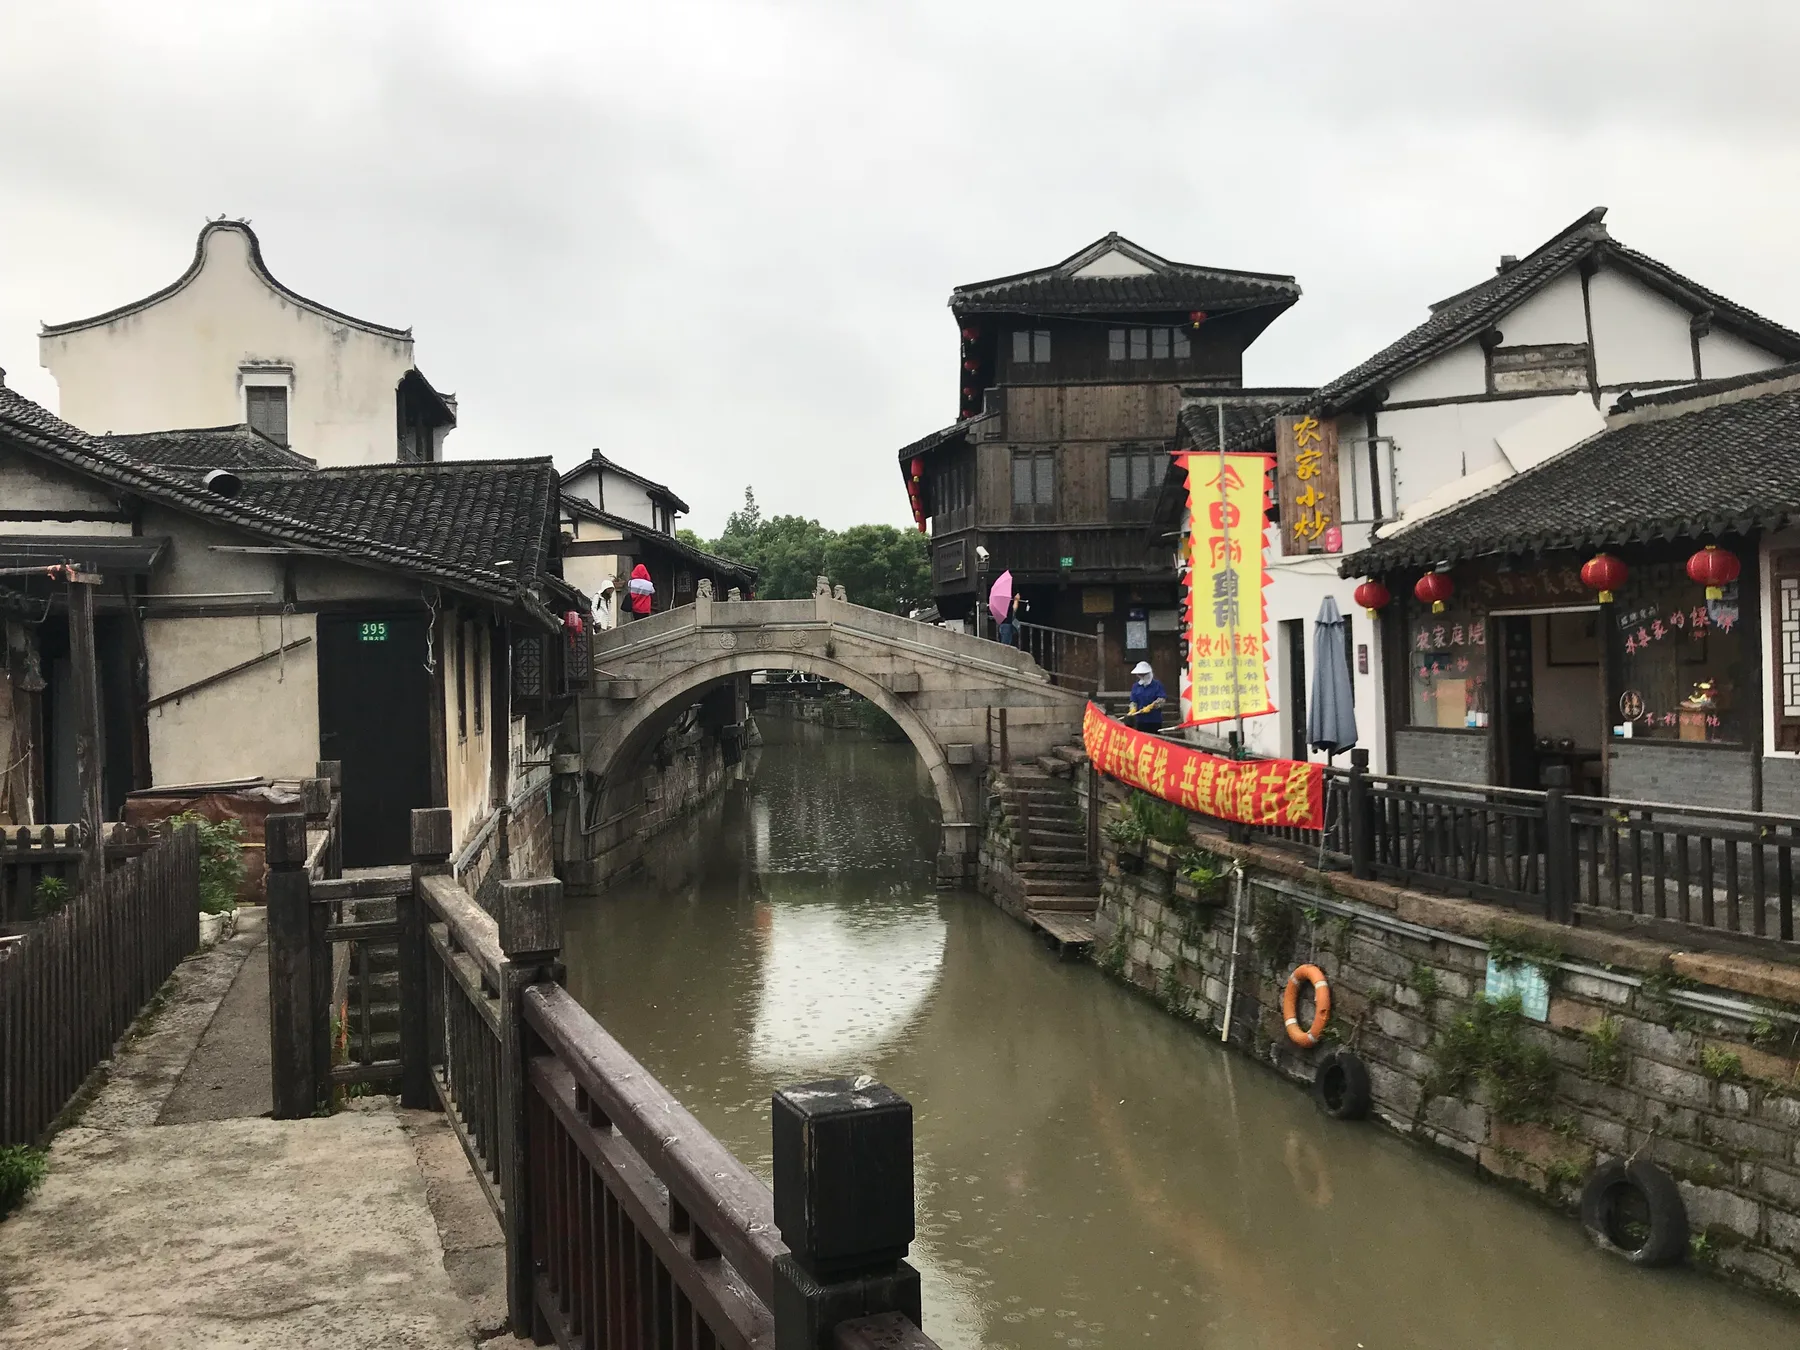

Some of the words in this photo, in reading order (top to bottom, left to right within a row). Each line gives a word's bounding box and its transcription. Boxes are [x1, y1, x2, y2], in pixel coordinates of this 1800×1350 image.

[1293, 416, 1330, 541] 农家小炒
[362, 623, 385, 635] 395
[1416, 623, 1486, 651] 农家庭院
